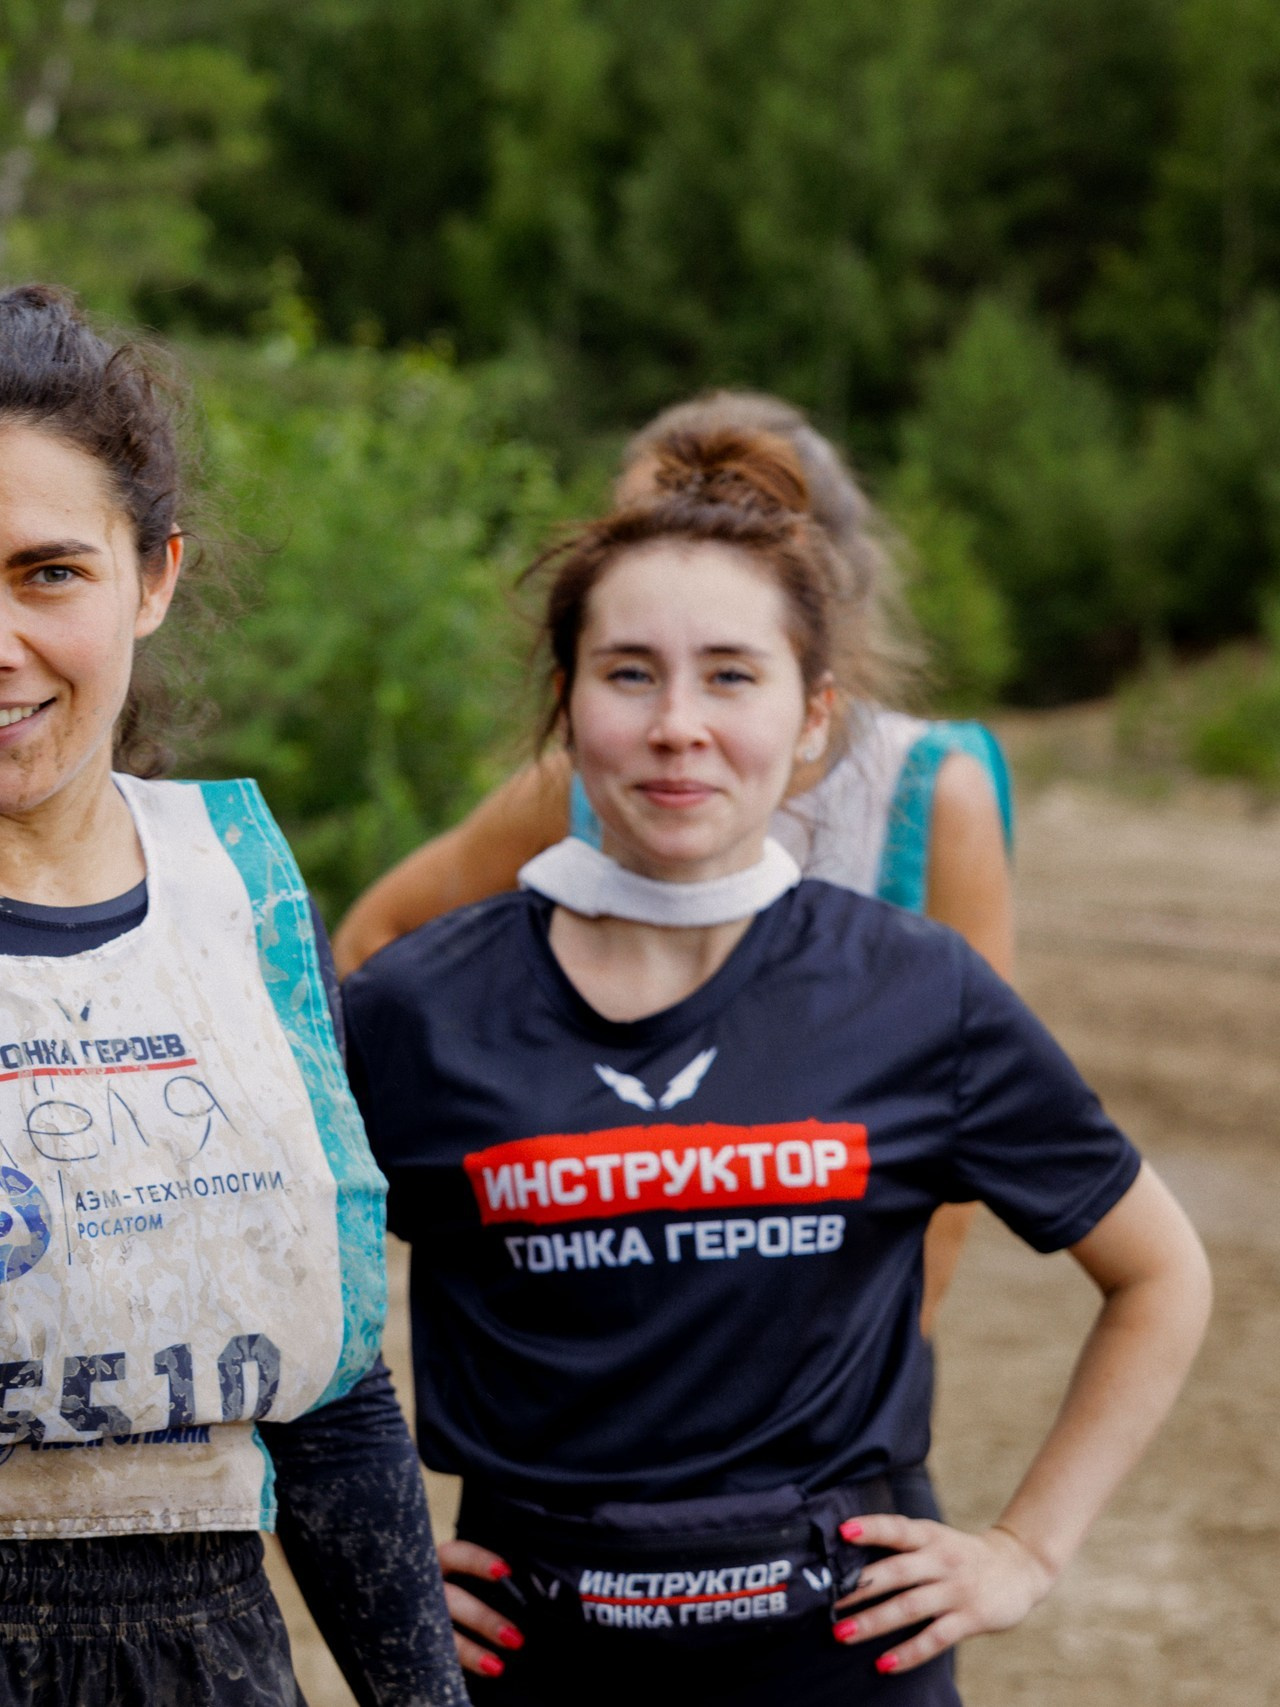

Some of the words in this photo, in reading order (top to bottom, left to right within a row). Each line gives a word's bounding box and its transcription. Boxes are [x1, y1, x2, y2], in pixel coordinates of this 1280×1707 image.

[79, 1033, 186, 1065] ГЕРОЕВ
[75, 1171, 285, 1213] АЭМ-ТЕХНОЛОГИИ
[482, 1139, 849, 1211] ИНСТРУКТОР
[77, 1213, 164, 1239] РОСАТОМ
[505, 1227, 654, 1274] ГОНКА
[665, 1214, 846, 1263] ГЕРОЕВ
[579, 1560, 792, 1599] ИНСТРУКТОР
[582, 1601, 674, 1629] ГОНКА
[678, 1591, 788, 1626] ГЕРОЕВ
